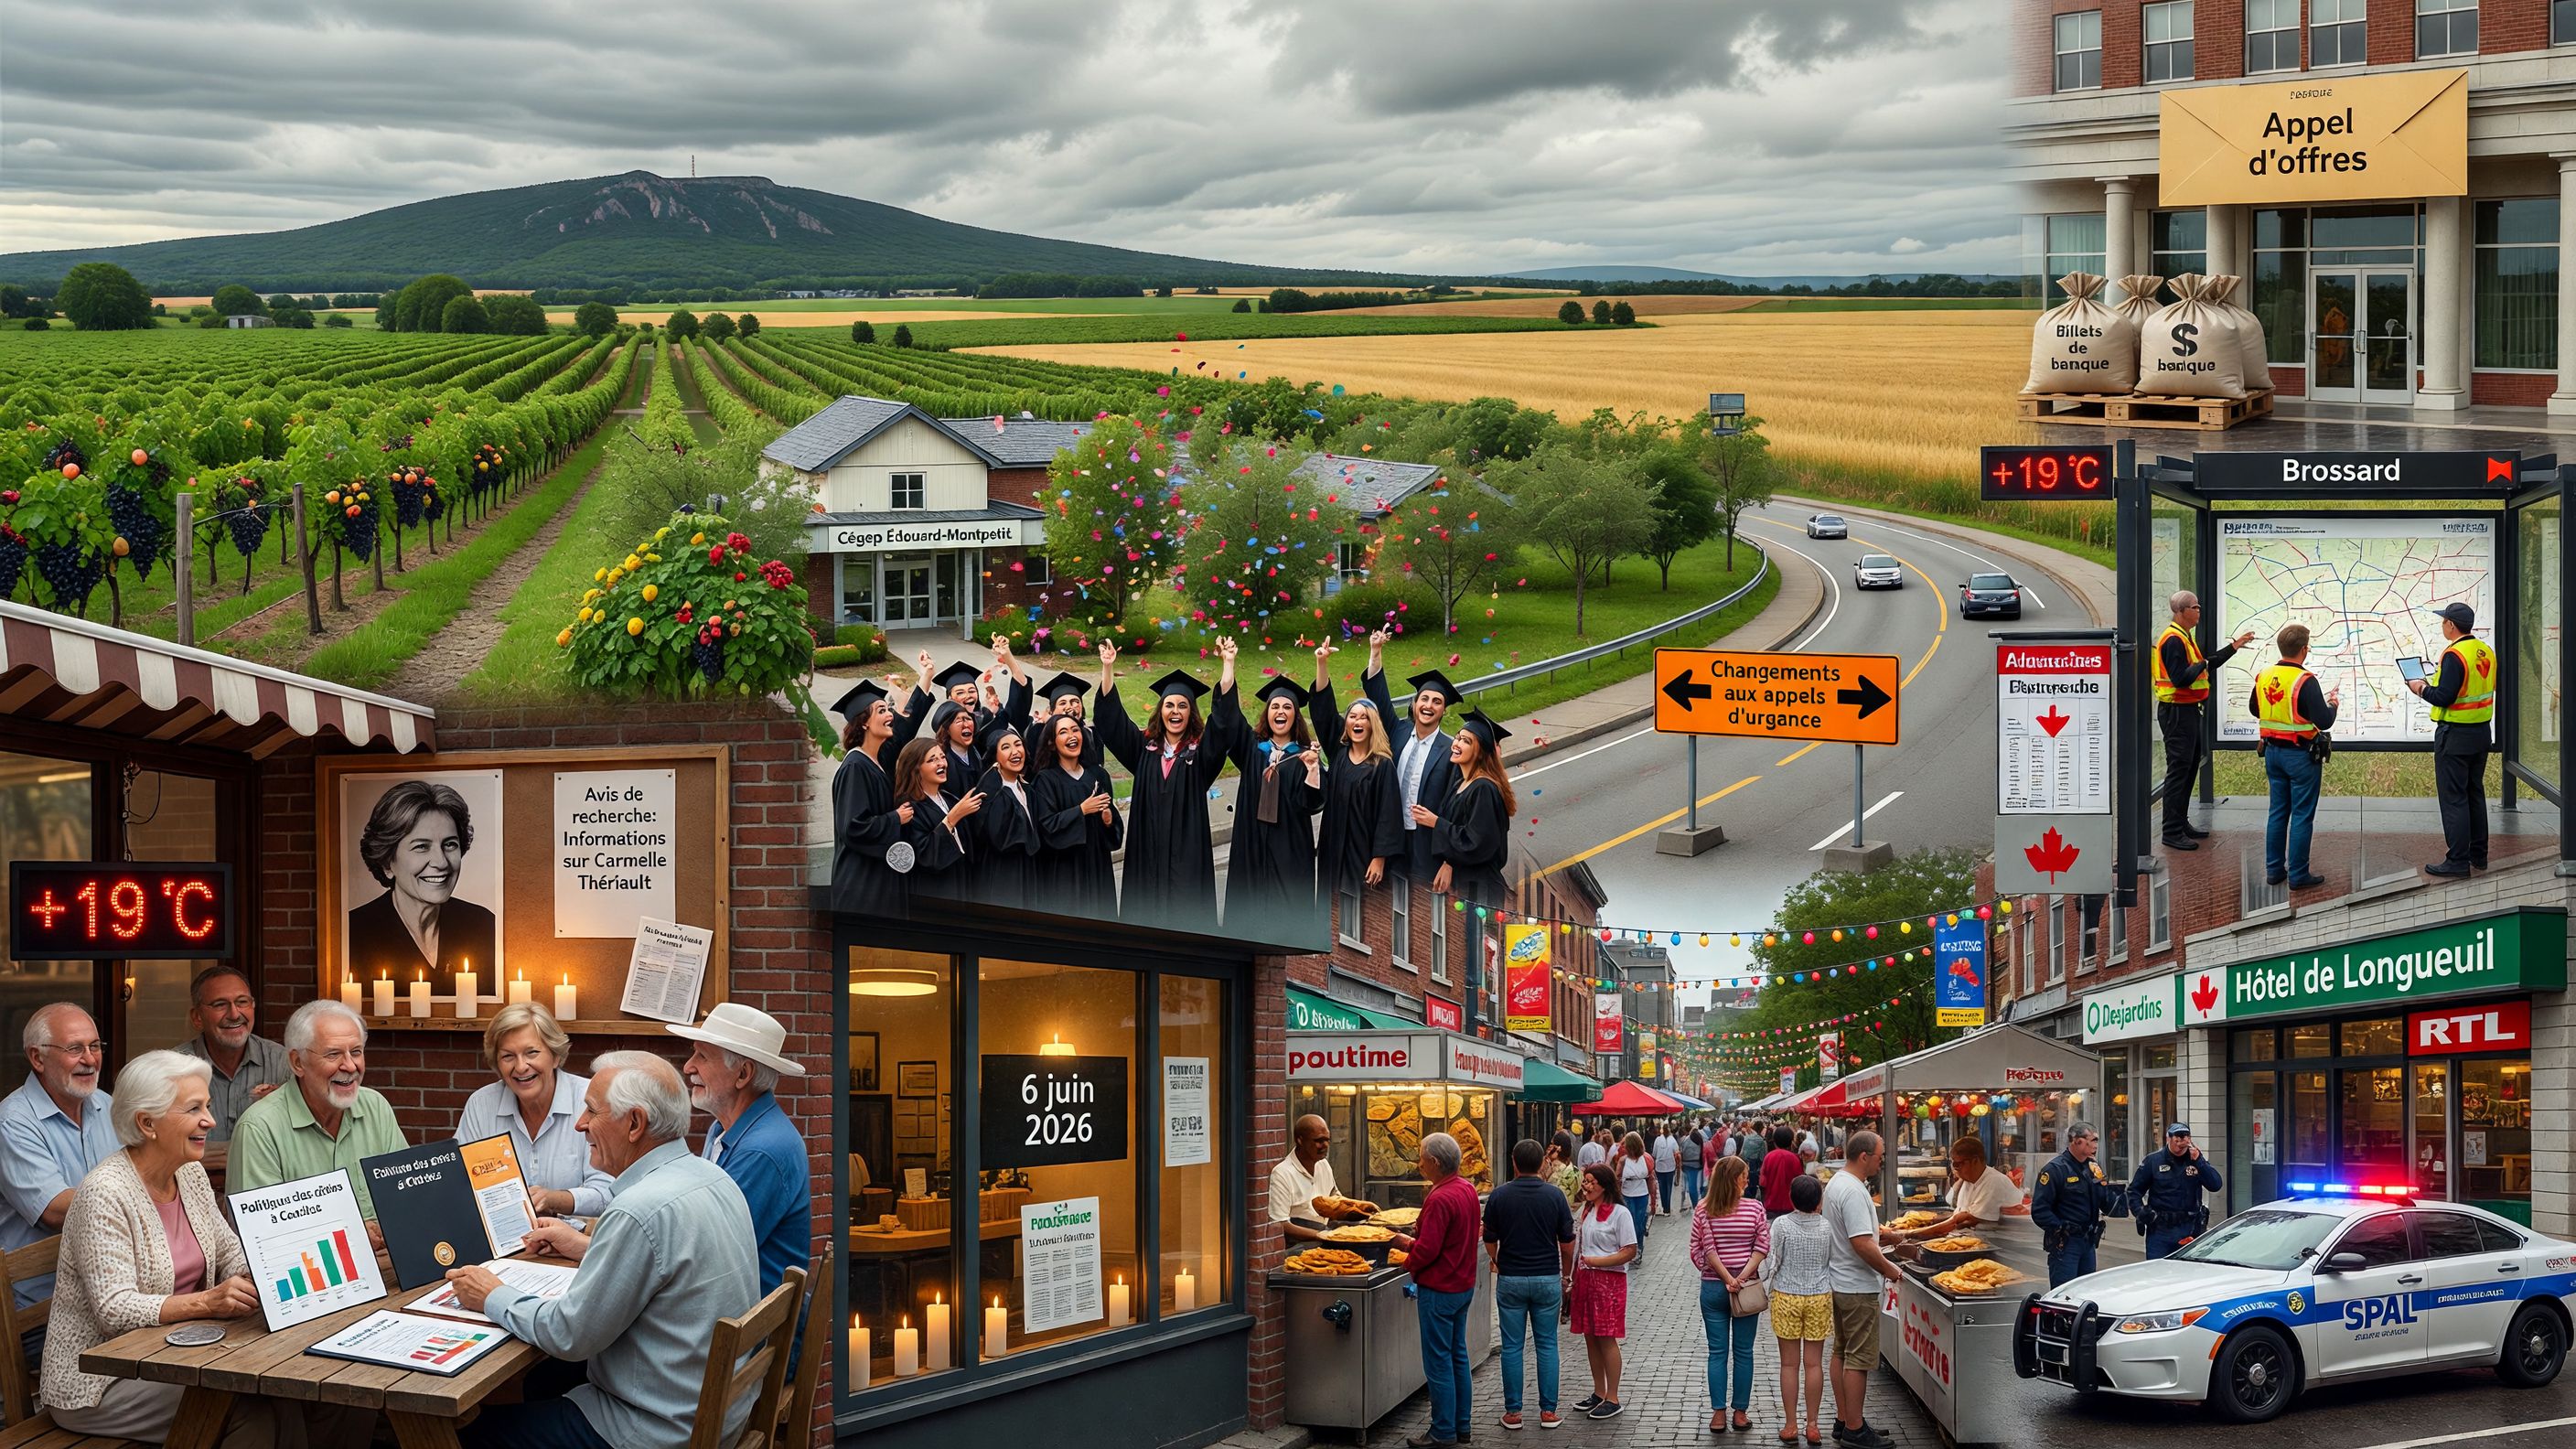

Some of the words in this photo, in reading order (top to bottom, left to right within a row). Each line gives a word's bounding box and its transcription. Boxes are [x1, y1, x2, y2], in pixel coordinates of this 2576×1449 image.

[2262, 107, 2353, 144] Appel
[2249, 146, 2367, 176] d'offres
[2056, 325, 2103, 338] Billets
[2068, 341, 2088, 354] de
[2283, 457, 2400, 482] Brossard
[837, 531, 883, 547] Cégep
[886, 528, 1013, 543] Édouard-Montpetit
[1712, 660, 1841, 683] Changements
[1724, 688, 1756, 702] aux
[1764, 687, 1826, 707] appels
[1728, 707, 1821, 730] d'urgance
[585, 786, 618, 801] Avis
[624, 786, 643, 801] de
[573, 808, 657, 823] recherche:
[564, 831, 666, 846] Informations
[563, 857, 590, 868] sur
[595, 852, 667, 867] Carmelle
[2236, 961, 2295, 1003] Hôtel
[2303, 958, 2334, 993] de
[2344, 928, 2495, 992] Longueuil
[2102, 994, 2163, 1030] Desjardins
[2420, 1012, 2516, 1046] RTL
[1288, 1045, 1407, 1075] poutime
[1022, 1073, 1038, 1104] 6
[1044, 1073, 1094, 1112] juin
[1025, 1112, 1093, 1146] 2026
[2345, 1293, 2418, 1331] SPAL
